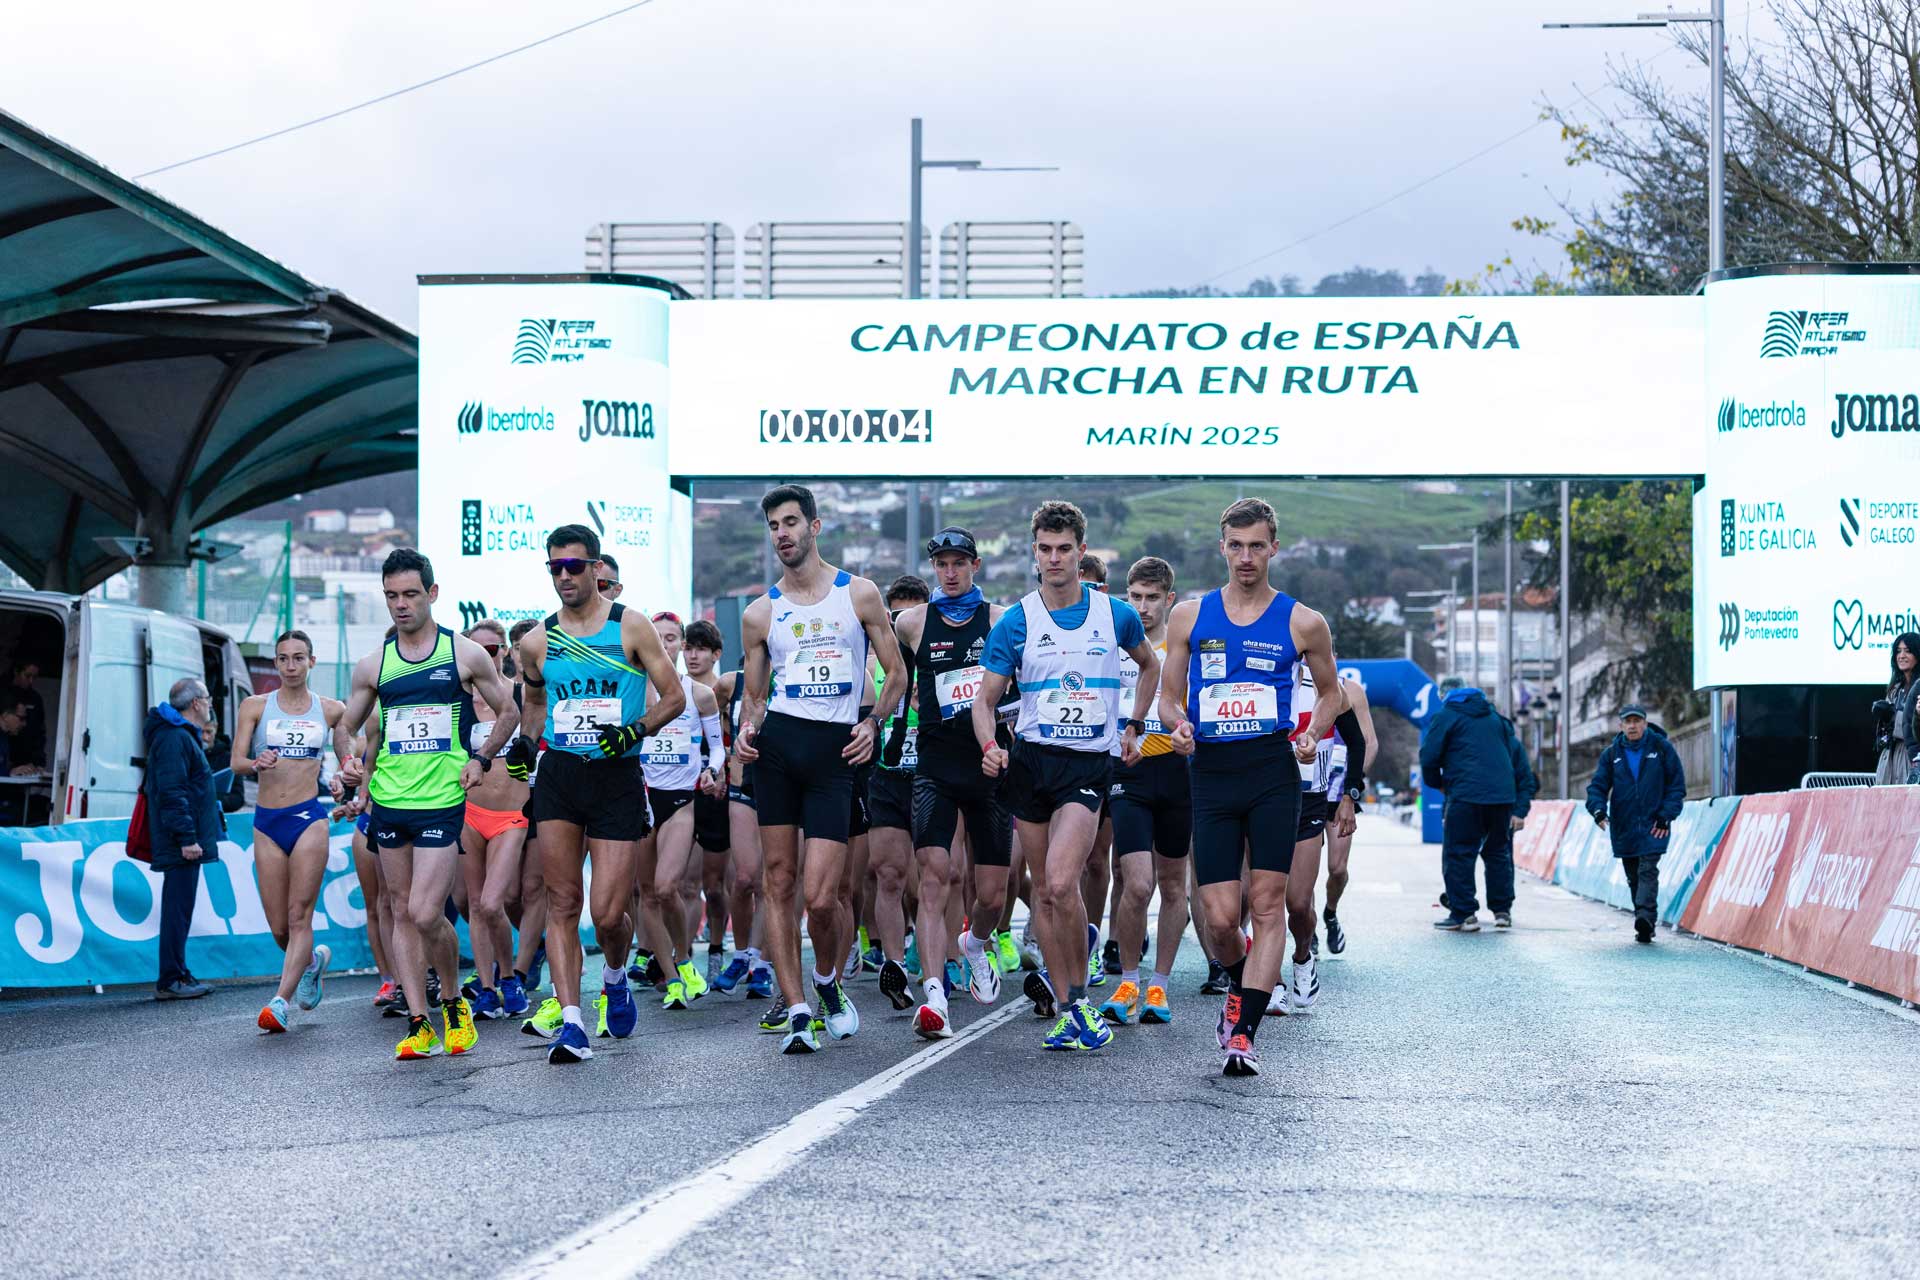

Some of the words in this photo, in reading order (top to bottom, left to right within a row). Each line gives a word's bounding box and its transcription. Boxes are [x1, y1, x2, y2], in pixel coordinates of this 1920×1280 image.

[1808, 312, 1848, 329] RFEA
[851, 323, 1227, 352] CAMPEONATO
[1241, 322, 1299, 350] de
[1314, 315, 1520, 350] ESPAÑA
[1805, 331, 1866, 342] ATLETISMO
[554, 338, 612, 349] ATLETISMO
[1800, 346, 1838, 357] MARCHA
[950, 366, 1183, 394] MARCHA
[1199, 367, 1267, 393] EN
[1282, 366, 1418, 394] RUTA
[488, 406, 554, 432] Iberdrola
[579, 400, 655, 442] Joma
[1739, 400, 1806, 429] Iberdrola
[1831, 394, 1920, 438] Joma
[760, 410, 931, 442] 00:00:04
[1087, 423, 1192, 445] MARÍN
[1201, 426, 1278, 445] 2025
[488, 504, 534, 524] XUNTA
[616, 506, 653, 524] DEPORTE
[1740, 502, 1785, 523] XUNTA
[1870, 503, 1918, 519] DEPORTE
[488, 531, 504, 550] DE
[509, 530, 548, 550] GALIC
[616, 530, 649, 546] GALEGO
[1740, 531, 1754, 550] DE
[1759, 529, 1817, 550] GALICIA
[1870, 527, 1915, 543] GALEGO
[1745, 607, 1798, 624] Deputación
[1745, 627, 1798, 639] Pontevedra
[1259, 642, 1283, 651] energie
[808, 666, 830, 682] 19
[556, 678, 618, 700] UCAM
[798, 684, 840, 698] Joma
[1060, 707, 1083, 724] 22
[1217, 700, 1257, 718] 404
[407, 722, 429, 738] 13
[574, 715, 597, 731] 25
[1216, 720, 1262, 735] Joma
[286, 733, 305, 746] 32
[566, 733, 600, 745] Jom
[1050, 726, 1093, 738] Joma
[399, 740, 439, 753] Joma
[654, 740, 673, 752] 33
[647, 754, 680, 764] Joma
